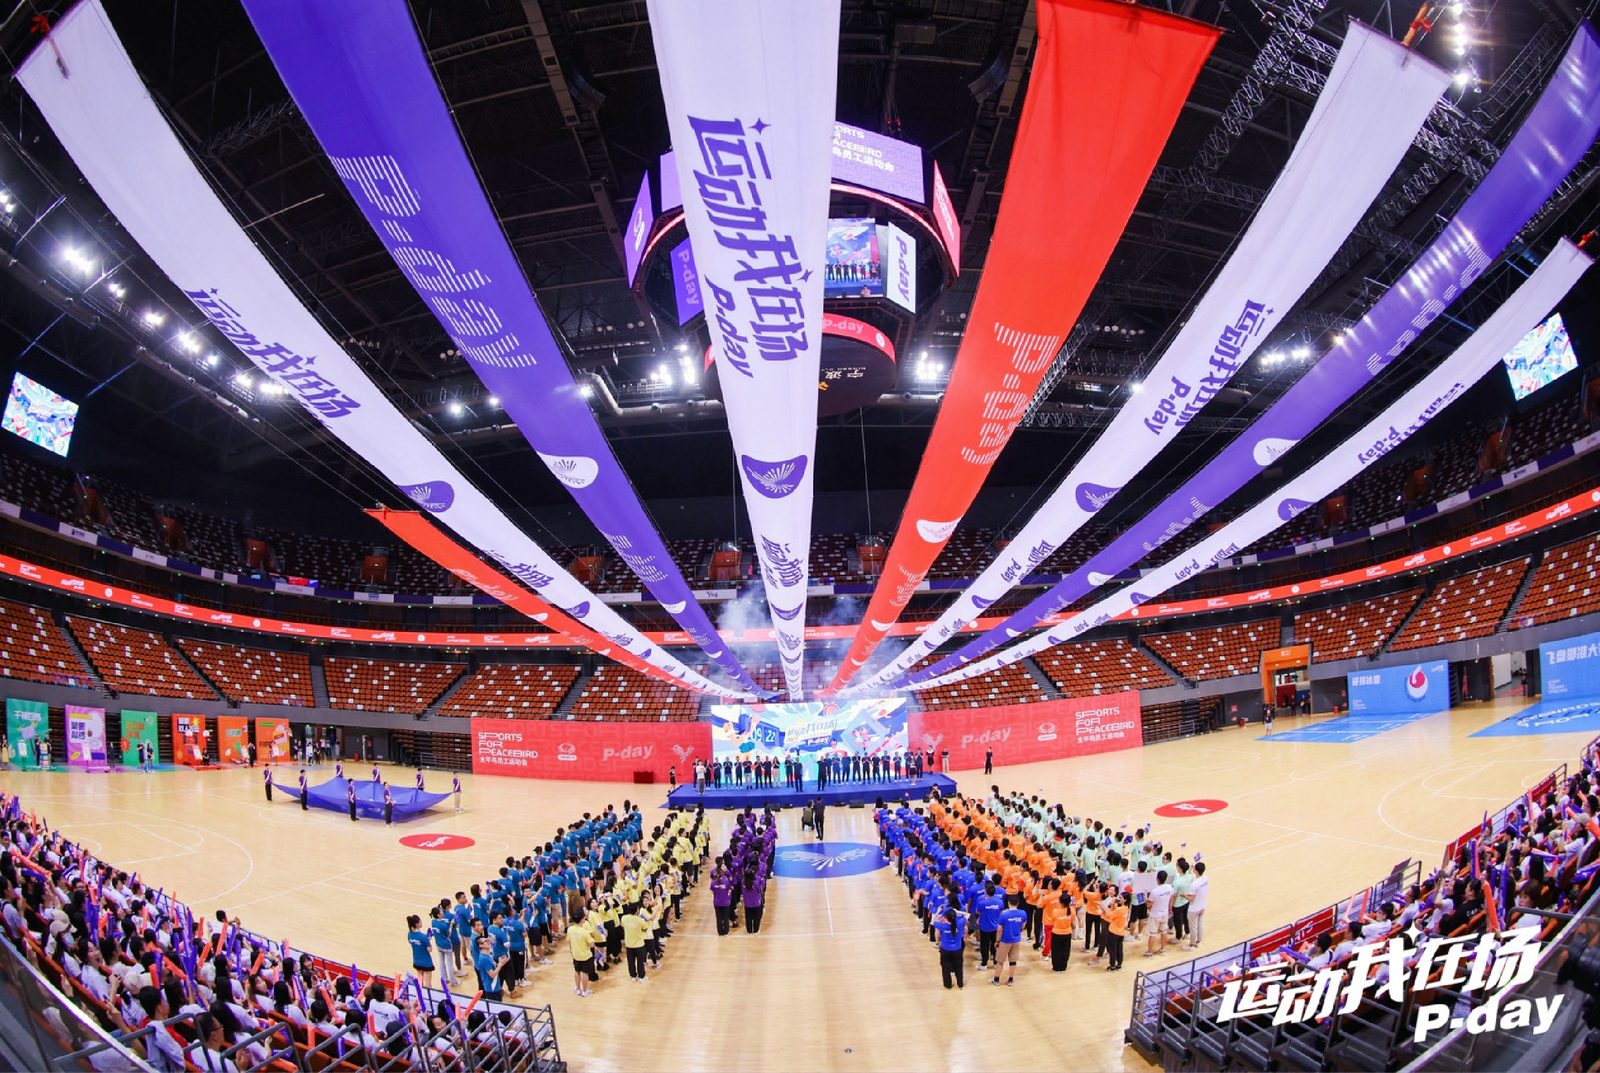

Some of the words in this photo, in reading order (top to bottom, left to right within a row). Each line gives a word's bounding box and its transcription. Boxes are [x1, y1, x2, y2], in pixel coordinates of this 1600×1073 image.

[835, 125, 865, 139] ORTS
[833, 139, 882, 158] ACEBIRD
[832, 147, 895, 172] 鸟员工运动会
[687, 115, 809, 361] 运动我在场
[1076, 707, 1120, 719] SPORTS
[1076, 718, 1101, 729] FOR
[1076, 721, 1135, 736] PEACEBIRD
[478, 732, 523, 742] SPORTS
[479, 740, 503, 748] FOR
[479, 748, 538, 758] PEACEBIRD
